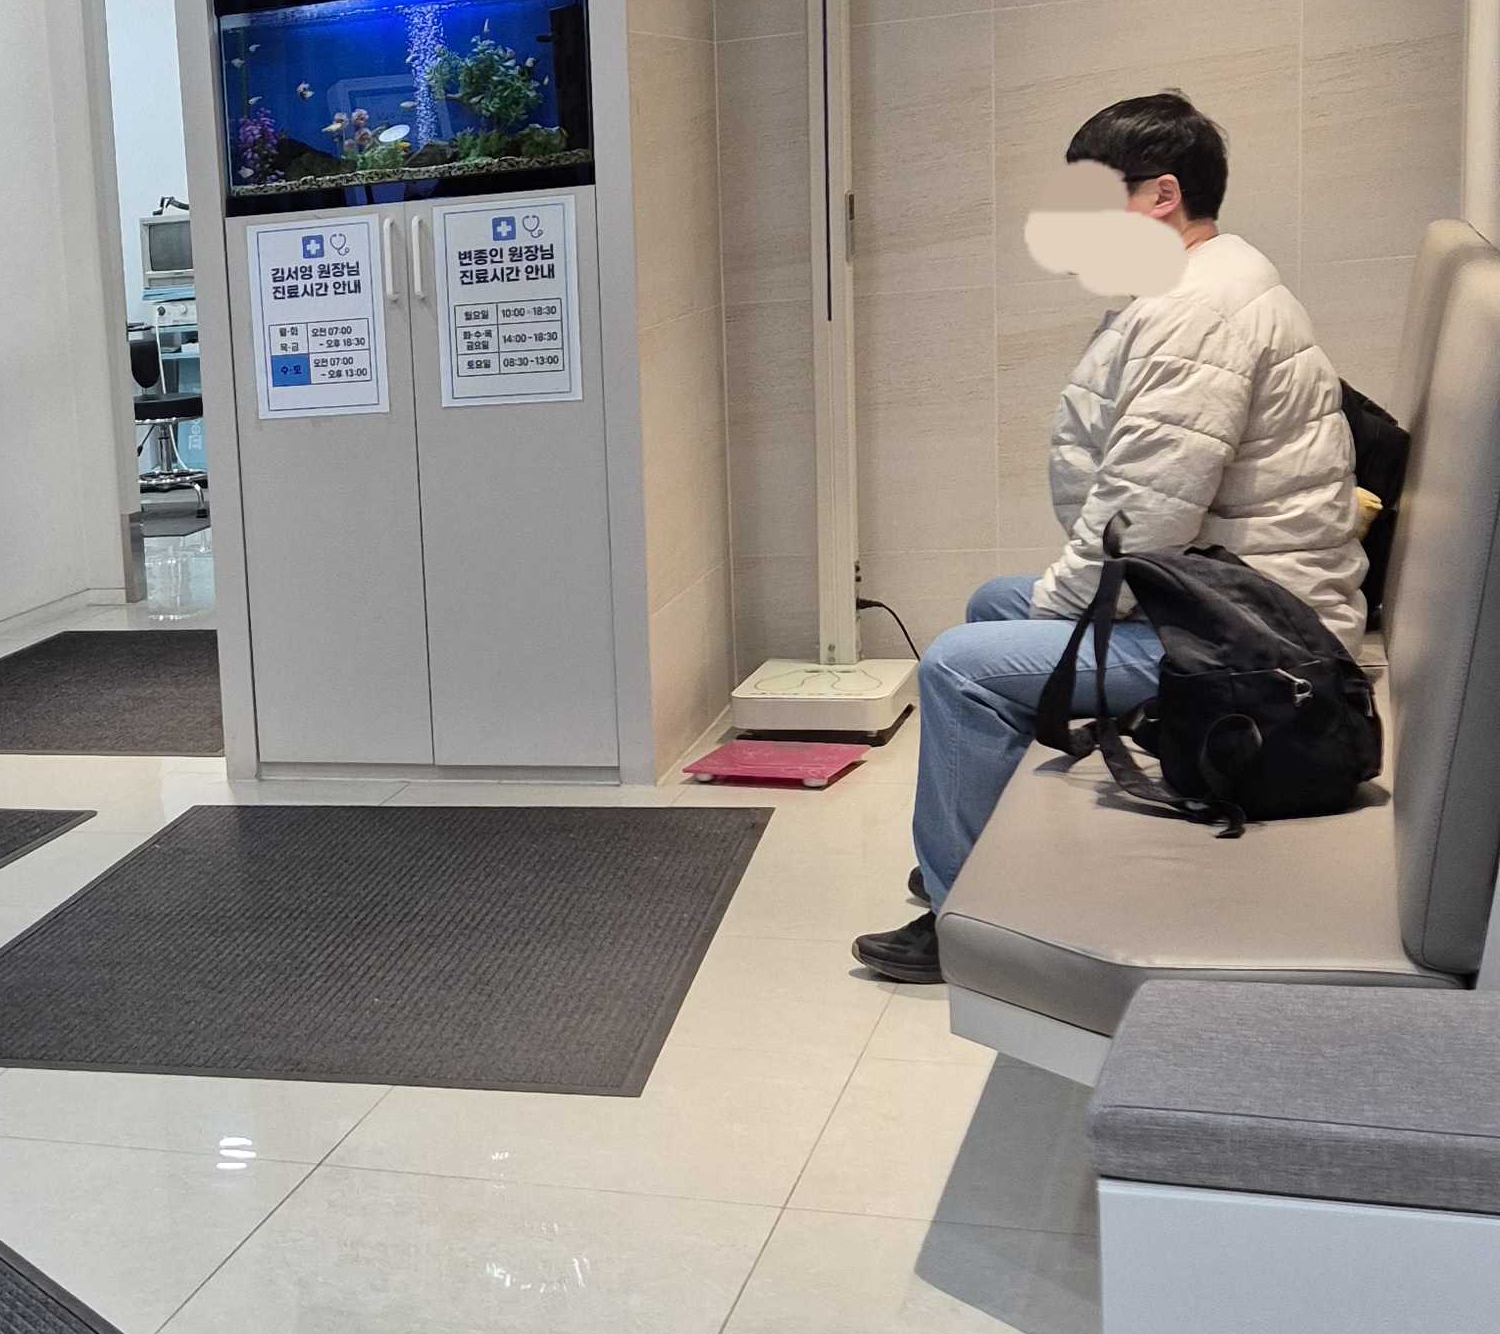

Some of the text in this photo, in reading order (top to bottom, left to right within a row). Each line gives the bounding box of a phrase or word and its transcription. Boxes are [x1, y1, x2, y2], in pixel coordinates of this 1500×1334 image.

[458, 243, 554, 266] 변종인 원장님
[271, 261, 360, 283] 김서영 원장님
[459, 263, 555, 286] 진료시간 안내
[272, 279, 361, 300] 진료시간 안내
[464, 310, 489, 321] 월요일
[501, 308, 525, 318] 10:00
[532, 305, 557, 316] 18:30
[311, 326, 352, 337] 오전 07:00
[502, 333, 527, 343] 14:00
[533, 331, 558, 342] 18:30
[326, 339, 340, 348] 오후
[343, 337, 366, 347] 18:30
[466, 340, 489, 351] 금요일
[313, 356, 354, 367] 오전 07:00
[467, 359, 491, 369] 토요일
[503, 357, 529, 367] 08:30
[535, 355, 559, 366] 13:00
[328, 369, 342, 379] 오후
[345, 368, 368, 377] 13:00
